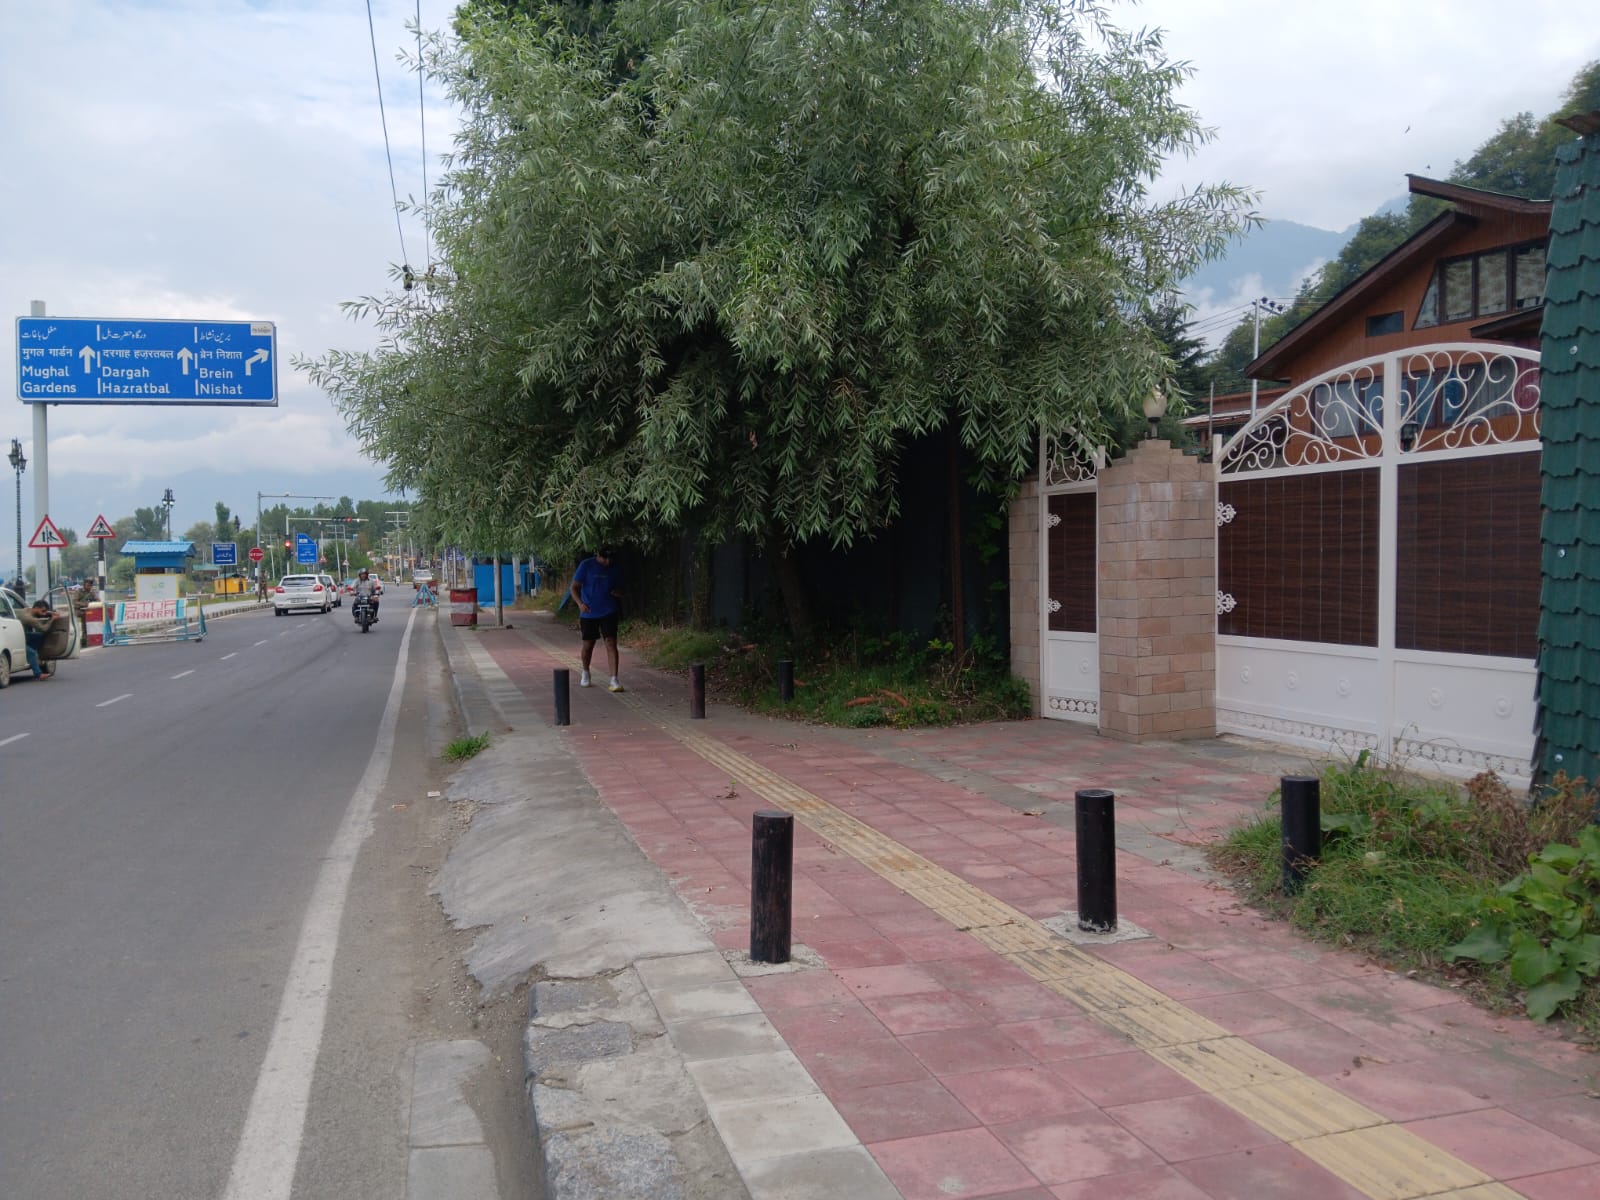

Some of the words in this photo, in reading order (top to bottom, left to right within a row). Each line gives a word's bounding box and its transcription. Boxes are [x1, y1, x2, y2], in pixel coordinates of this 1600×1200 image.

[22, 347, 45, 360] मुगल
[48, 345, 73, 357] गार्डन
[102, 349, 131, 359] दरगाह
[216, 348, 243, 360] निशात
[22, 365, 70, 379] Mughal
[102, 366, 150, 380] Dargah
[199, 367, 233, 379] Brein
[22, 381, 77, 393] Gardens
[102, 381, 171, 394] Hazratbal
[199, 383, 243, 395] Nishat
